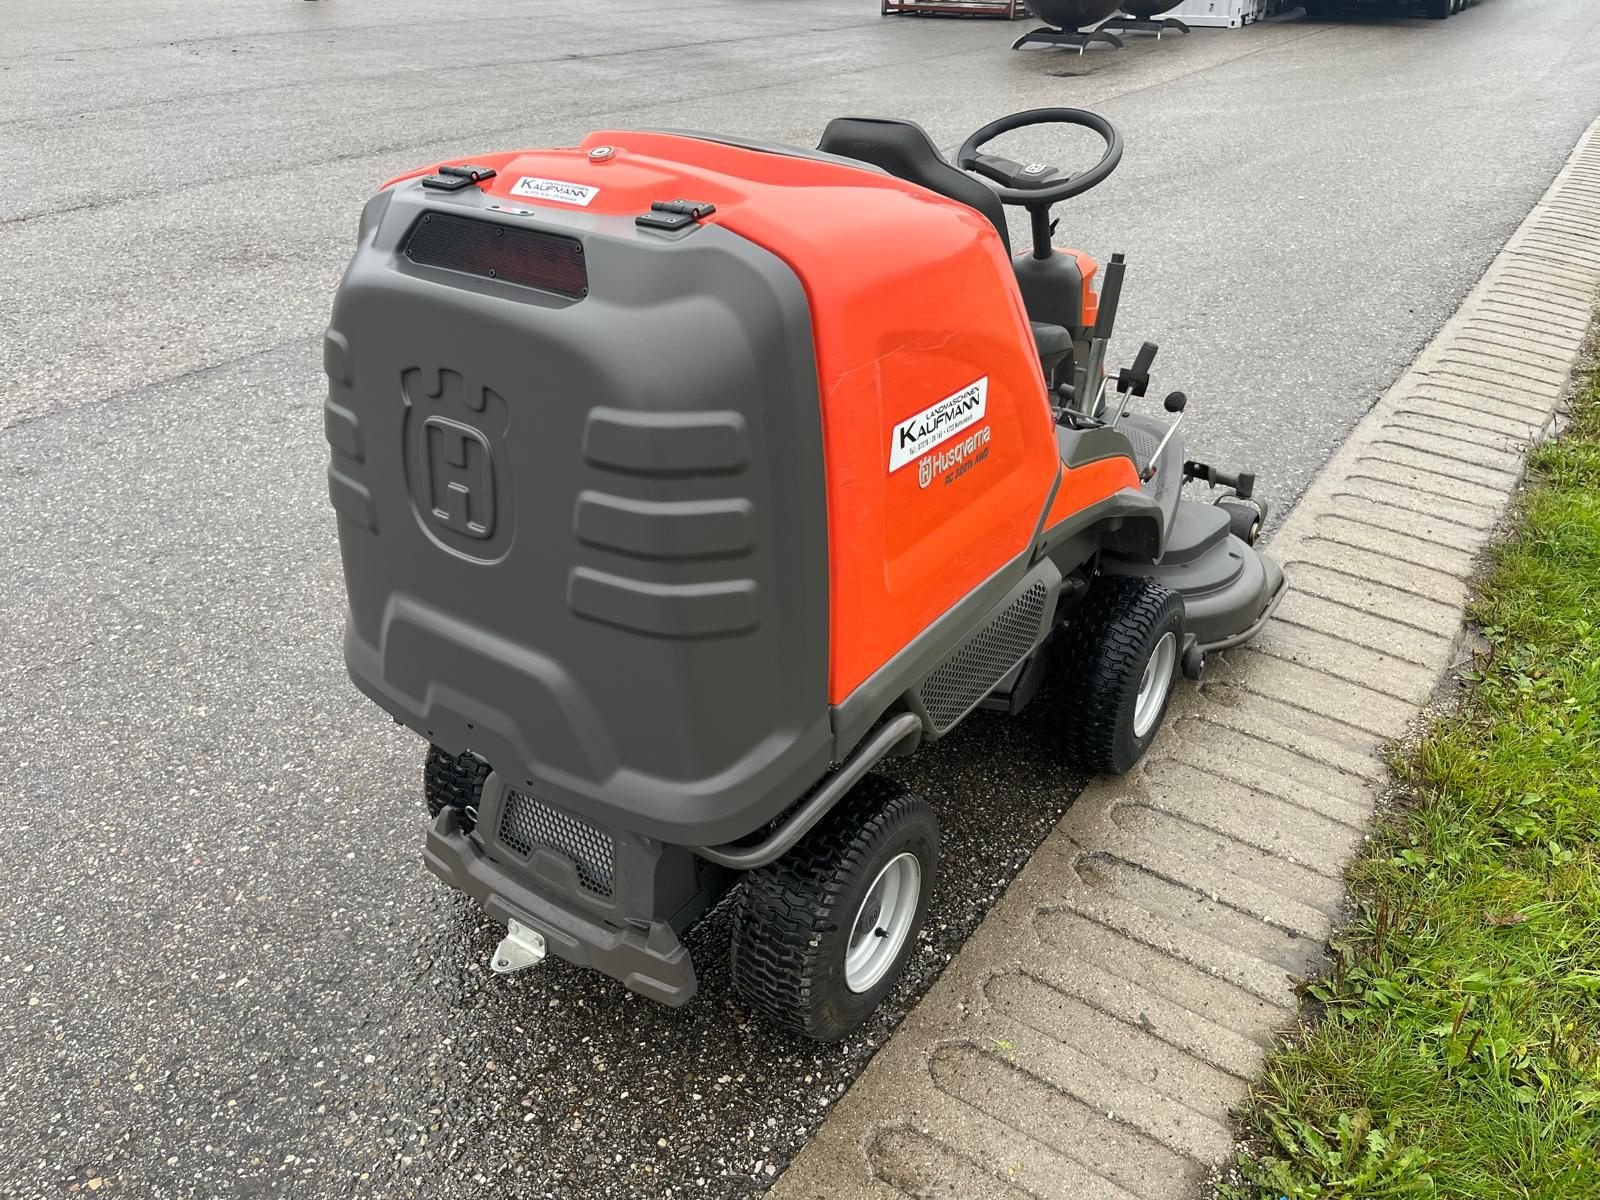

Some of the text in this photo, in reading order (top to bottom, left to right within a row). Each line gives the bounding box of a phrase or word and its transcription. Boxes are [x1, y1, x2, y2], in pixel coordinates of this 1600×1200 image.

[521, 179, 588, 198] KAUFMANN
[926, 385, 980, 420] LANDMASCHINEN
[900, 393, 980, 449] KAUFMANN
[932, 425, 991, 478] Husqvarna
[974, 447, 989, 465] AWD
